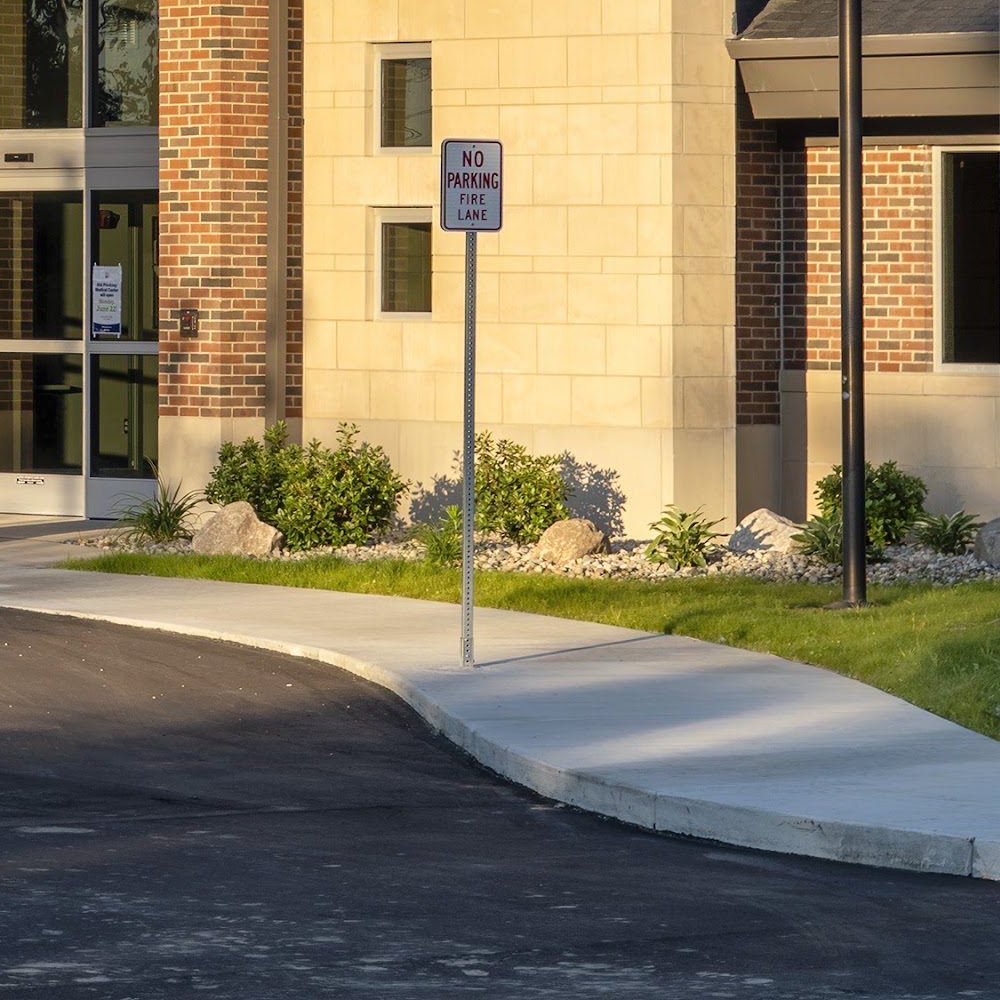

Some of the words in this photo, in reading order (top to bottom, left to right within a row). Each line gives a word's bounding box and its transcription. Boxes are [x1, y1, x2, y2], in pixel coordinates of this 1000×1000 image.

[462, 150, 484, 168] NO
[447, 172, 499, 189] PARKING
[460, 193, 486, 205] FIRE
[458, 209, 487, 221] LANE
